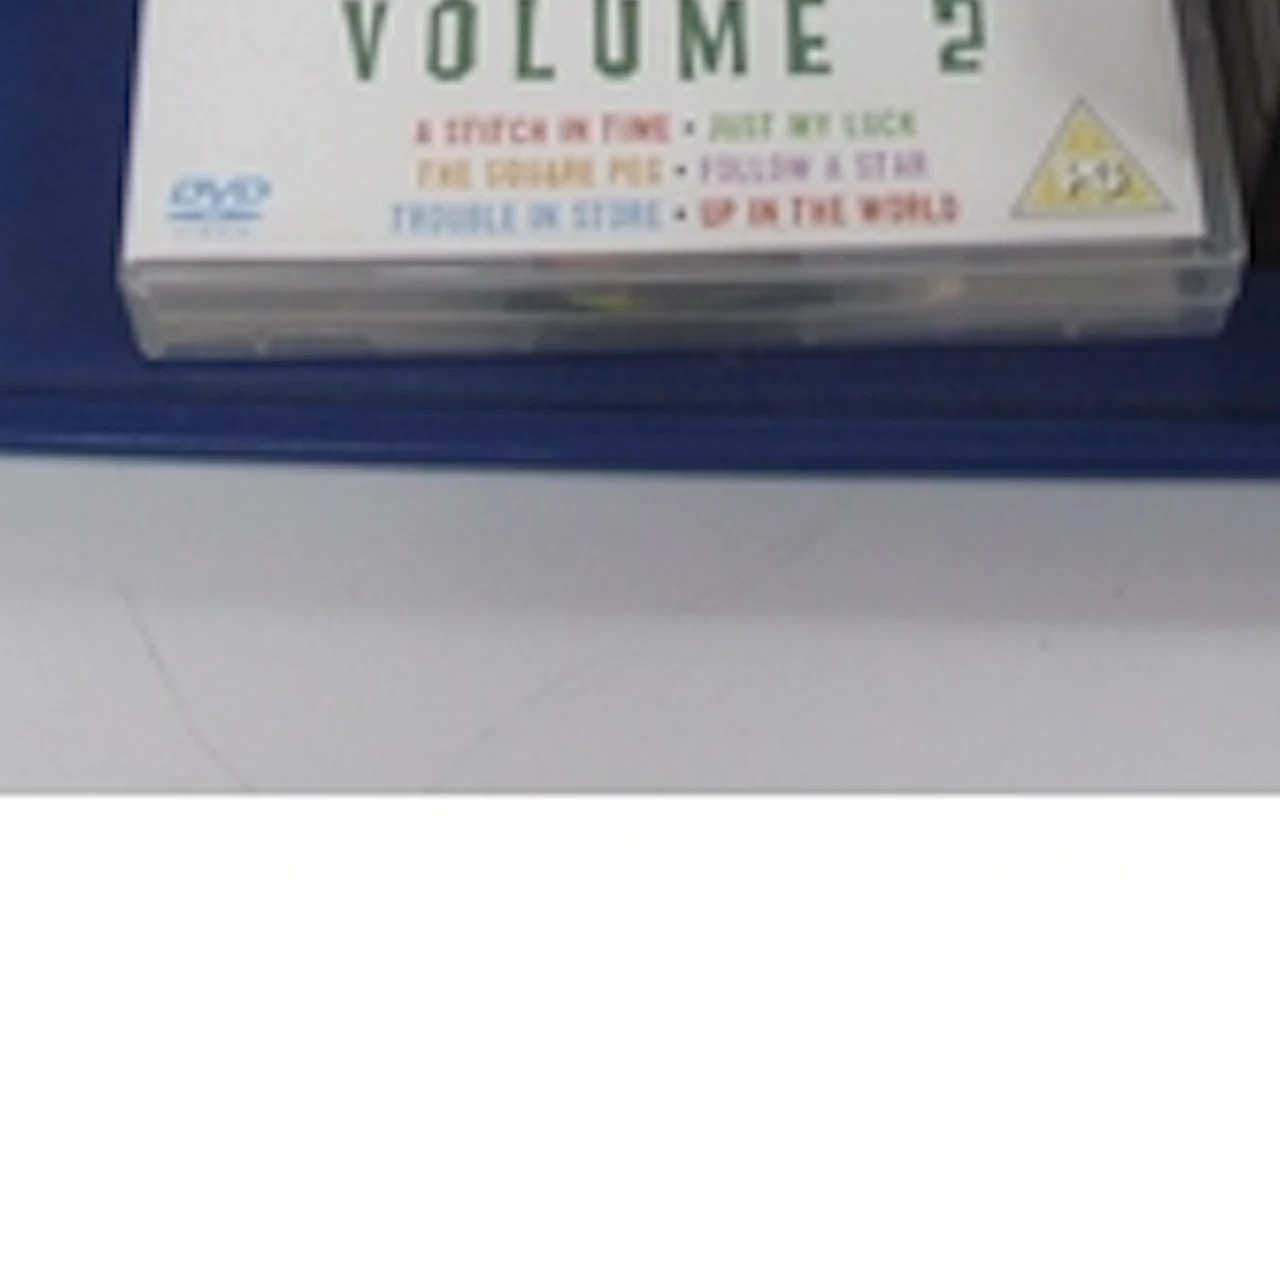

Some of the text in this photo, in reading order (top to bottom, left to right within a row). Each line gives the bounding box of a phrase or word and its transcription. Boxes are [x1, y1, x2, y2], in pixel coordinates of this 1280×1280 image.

[444, 114, 549, 144] STITCH
[559, 115, 589, 142] IN
[600, 112, 672, 144] TIME
[708, 111, 774, 142] JUST
[787, 110, 834, 138] MY
[842, 107, 917, 137] LUCK
[417, 157, 471, 188] THE
[484, 156, 595, 189] SQUARE
[701, 152, 811, 185] FOLLOW
[854, 148, 928, 180] STAR
[167, 176, 273, 208] DVD
[391, 190, 961, 235] TROUBLE IN STORE UP IN THE WORLD
